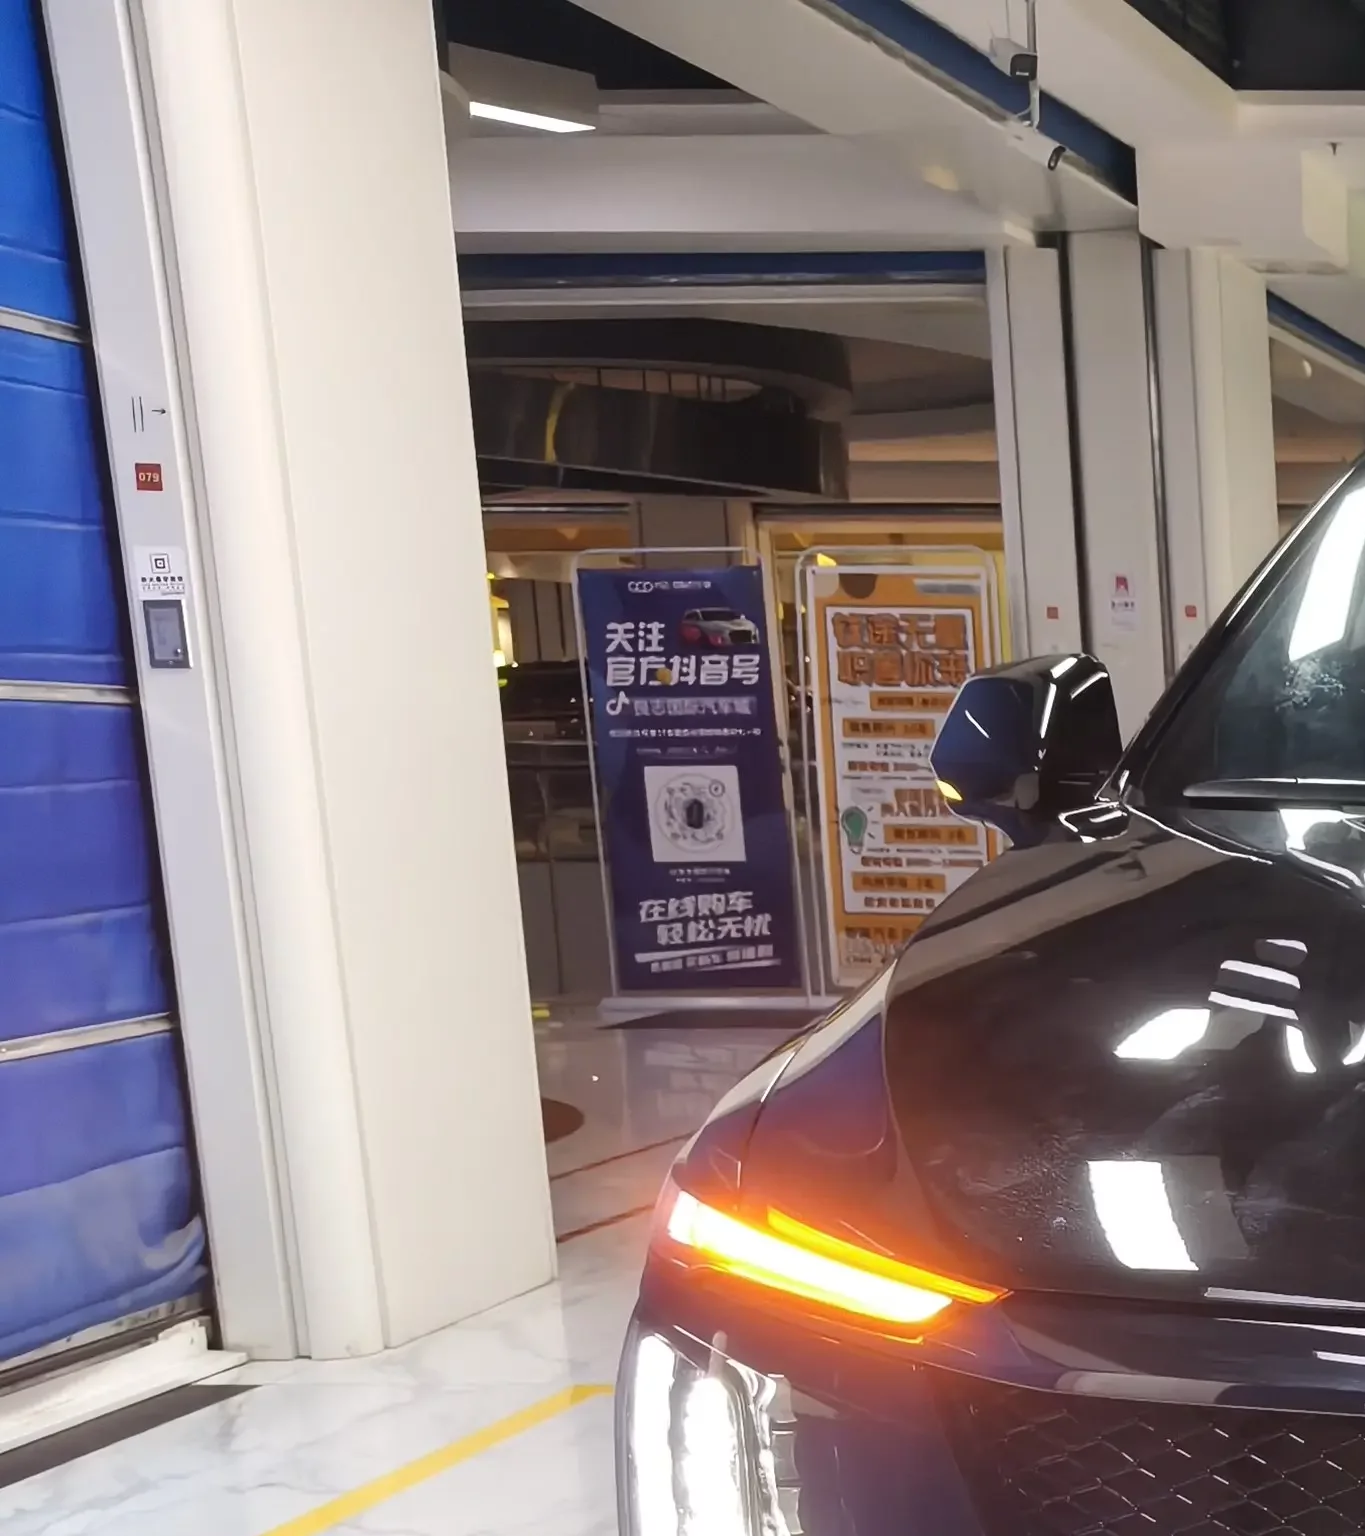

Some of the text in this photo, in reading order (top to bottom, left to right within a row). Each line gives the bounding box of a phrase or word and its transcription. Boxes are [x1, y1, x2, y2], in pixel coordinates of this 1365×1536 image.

[138, 471, 161, 483] 079
[605, 621, 666, 653] 关注
[605, 653, 761, 687] 官方抖音号
